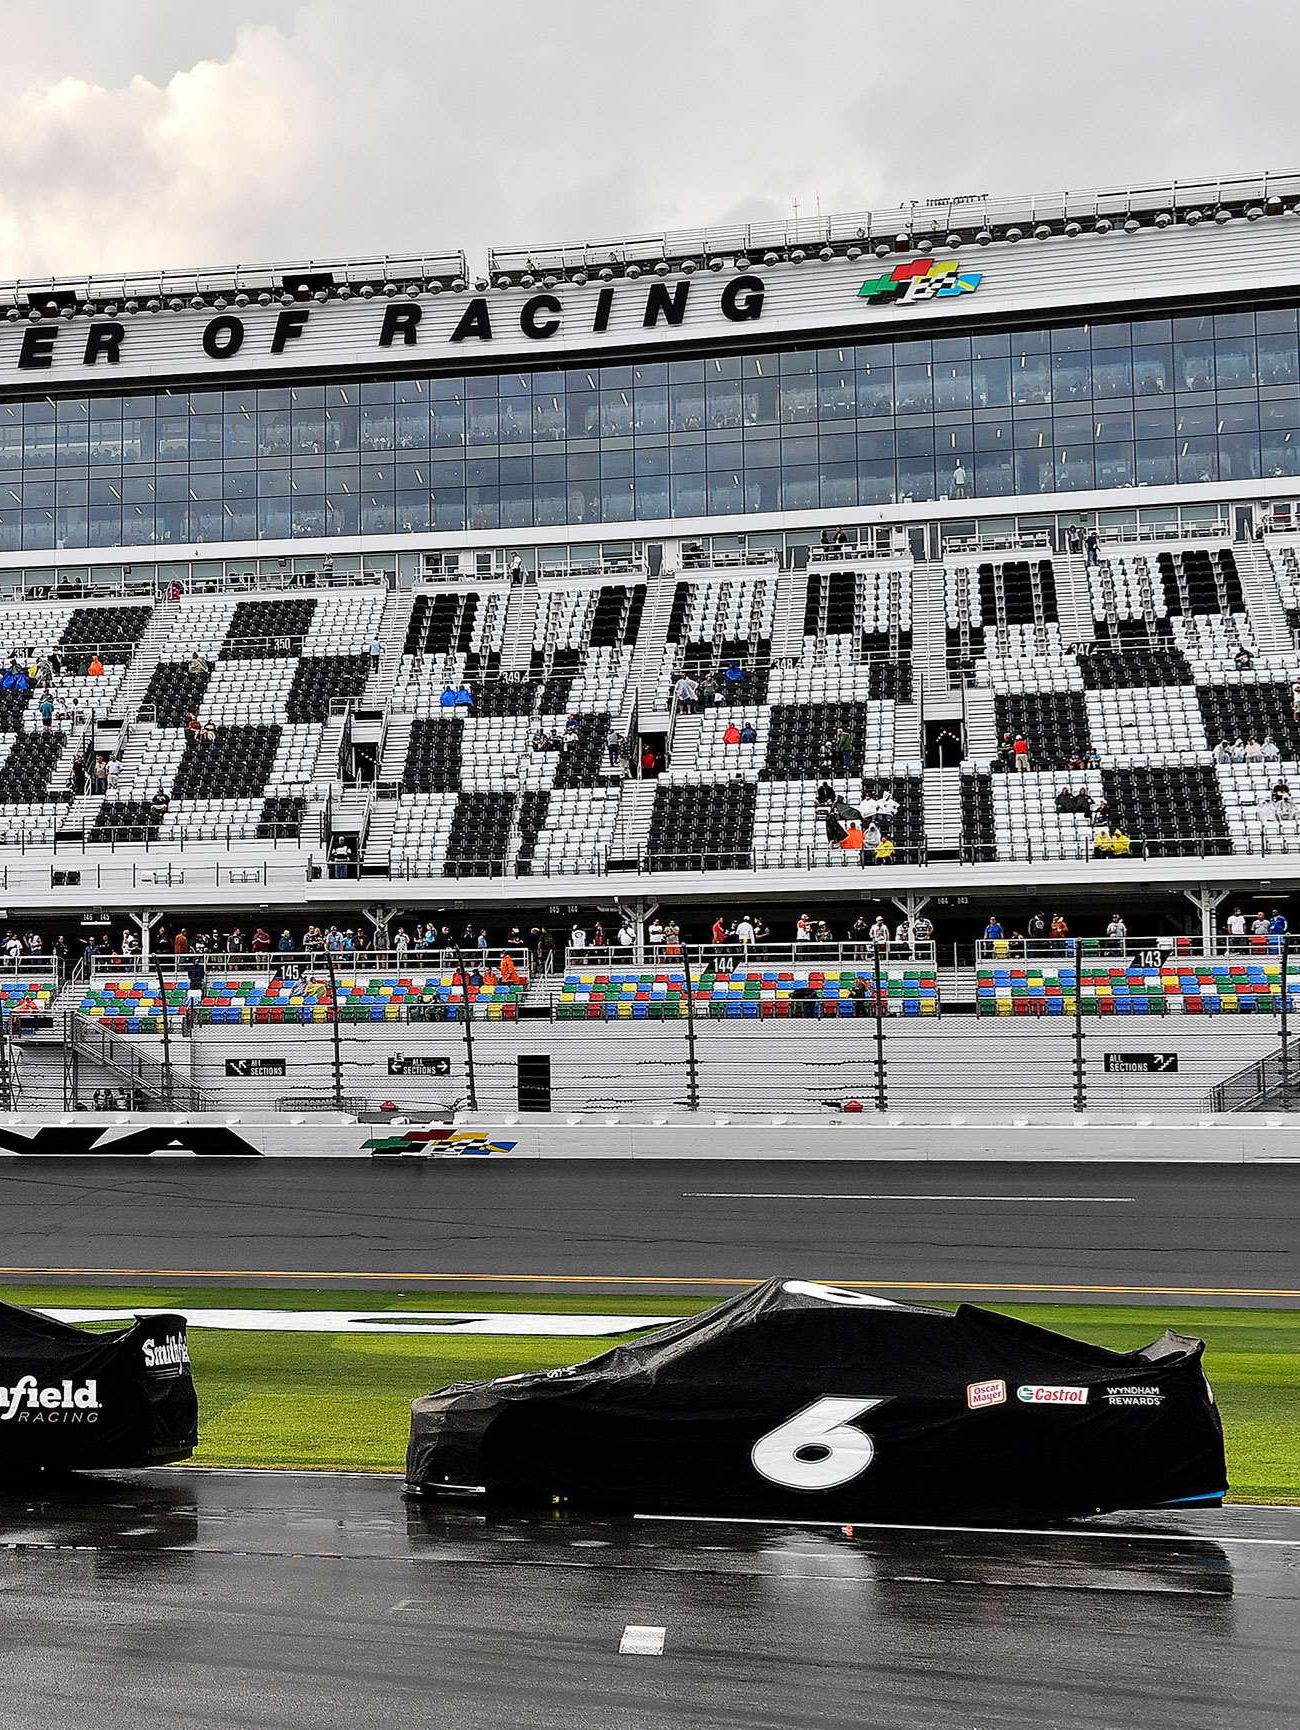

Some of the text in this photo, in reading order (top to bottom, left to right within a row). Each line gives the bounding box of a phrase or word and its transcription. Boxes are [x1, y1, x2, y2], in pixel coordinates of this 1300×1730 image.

[202, 309, 310, 359] OF
[378, 274, 766, 347] RACING
[34, 587, 43, 598] L2
[1071, 643, 1090, 656] 347
[774, 658, 793, 669] 348
[713, 957, 734, 972] 144
[1139, 951, 1161, 967] 143
[281, 965, 299, 980] 145
[412, 1058, 424, 1066] ALL
[1109, 1063, 1148, 1071] SECTIONS
[251, 1067, 283, 1075] SECTIONS
[403, 1066, 436, 1075] SECTIONS
[973, 1384, 1000, 1395] Oscar
[1035, 1388, 1083, 1402] Castrol
[1106, 1386, 1159, 1394] WYNDHAM
[973, 1391, 1001, 1403] Mayer
[1108, 1397, 1161, 1405] REWARDS
[18, 1411, 99, 1423] RACING
[751, 1395, 886, 1490] 6
